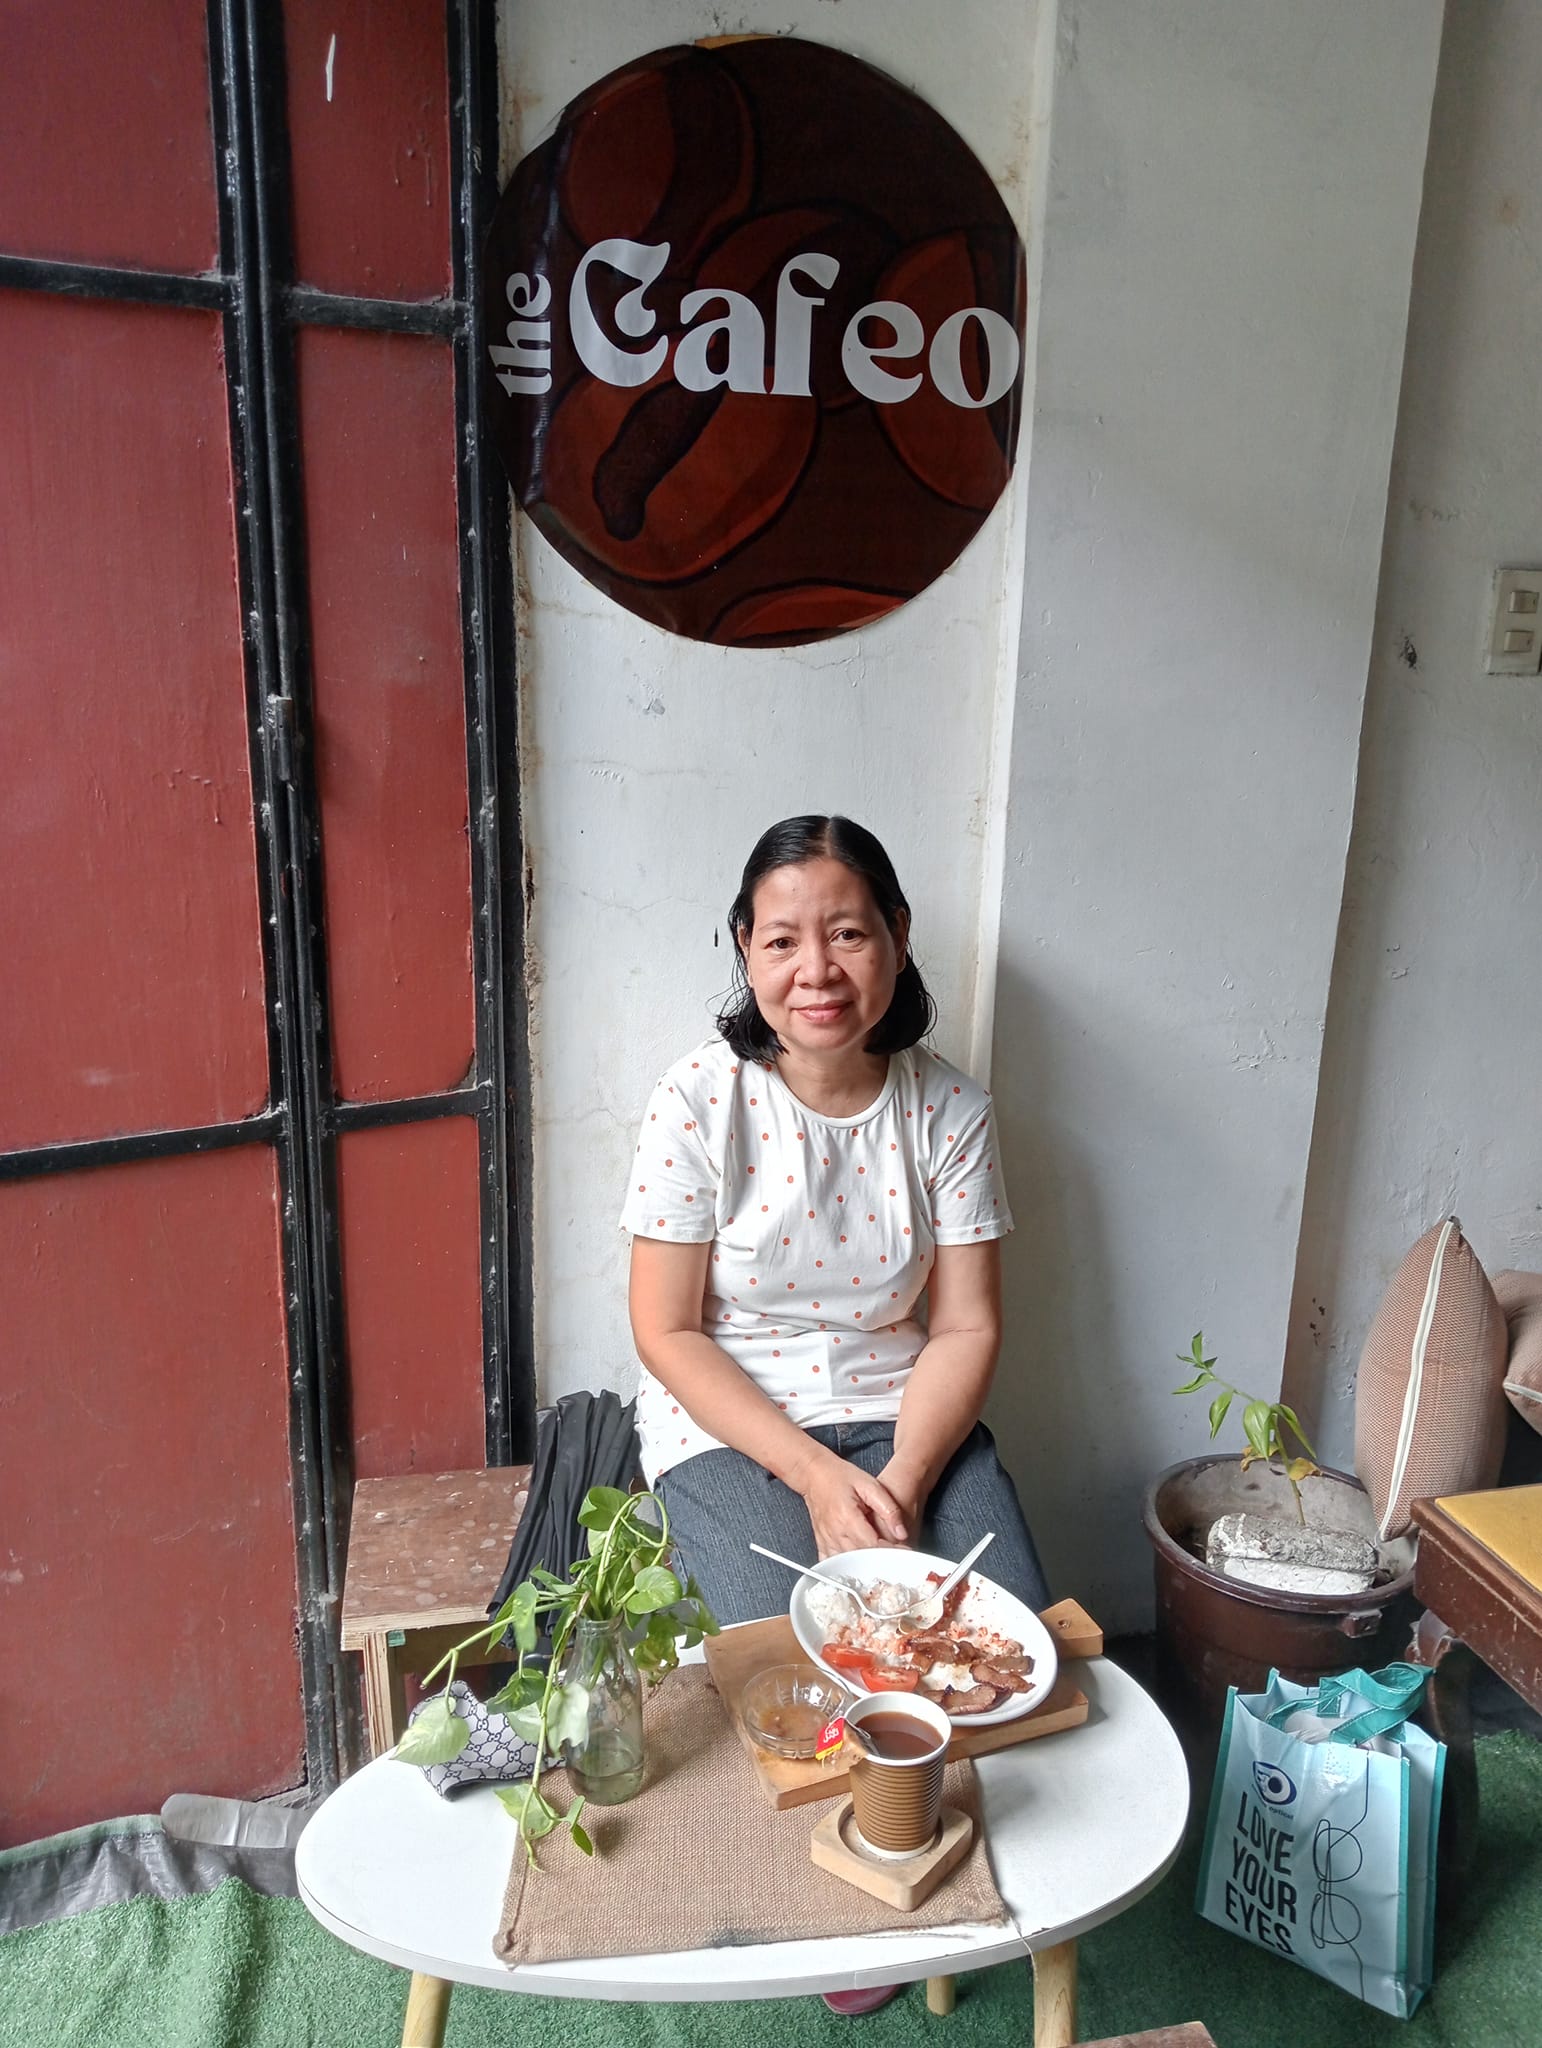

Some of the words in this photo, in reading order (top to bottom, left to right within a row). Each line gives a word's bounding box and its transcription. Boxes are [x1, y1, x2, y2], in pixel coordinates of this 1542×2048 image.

[488, 272, 552, 397] the
[1237, 1791, 1294, 1876] LOVE
[1226, 1880, 1297, 1955] EYES
[1232, 1836, 1297, 1925] YOUR
